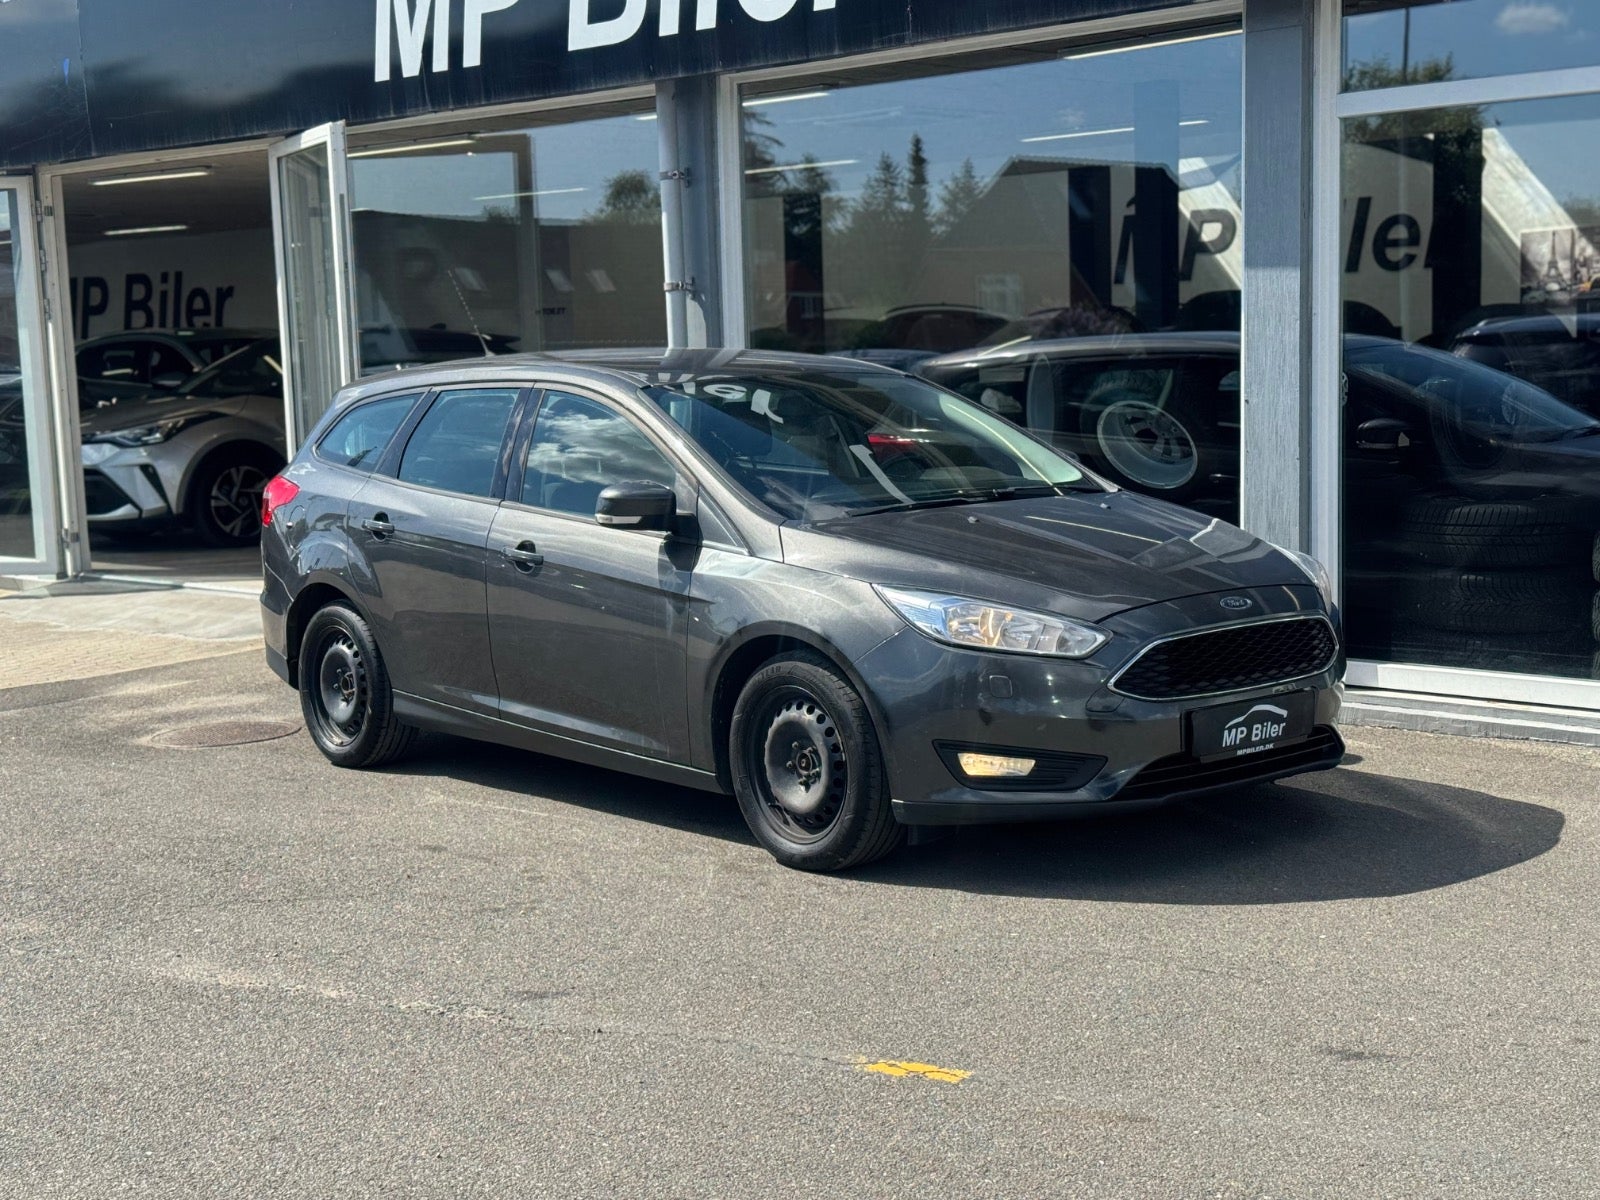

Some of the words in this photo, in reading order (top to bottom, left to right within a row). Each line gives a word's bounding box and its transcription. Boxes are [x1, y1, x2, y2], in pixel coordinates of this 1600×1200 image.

[124, 270, 235, 330] Biler
[1222, 727, 1247, 747] MP
[1251, 721, 1286, 741] Biler
